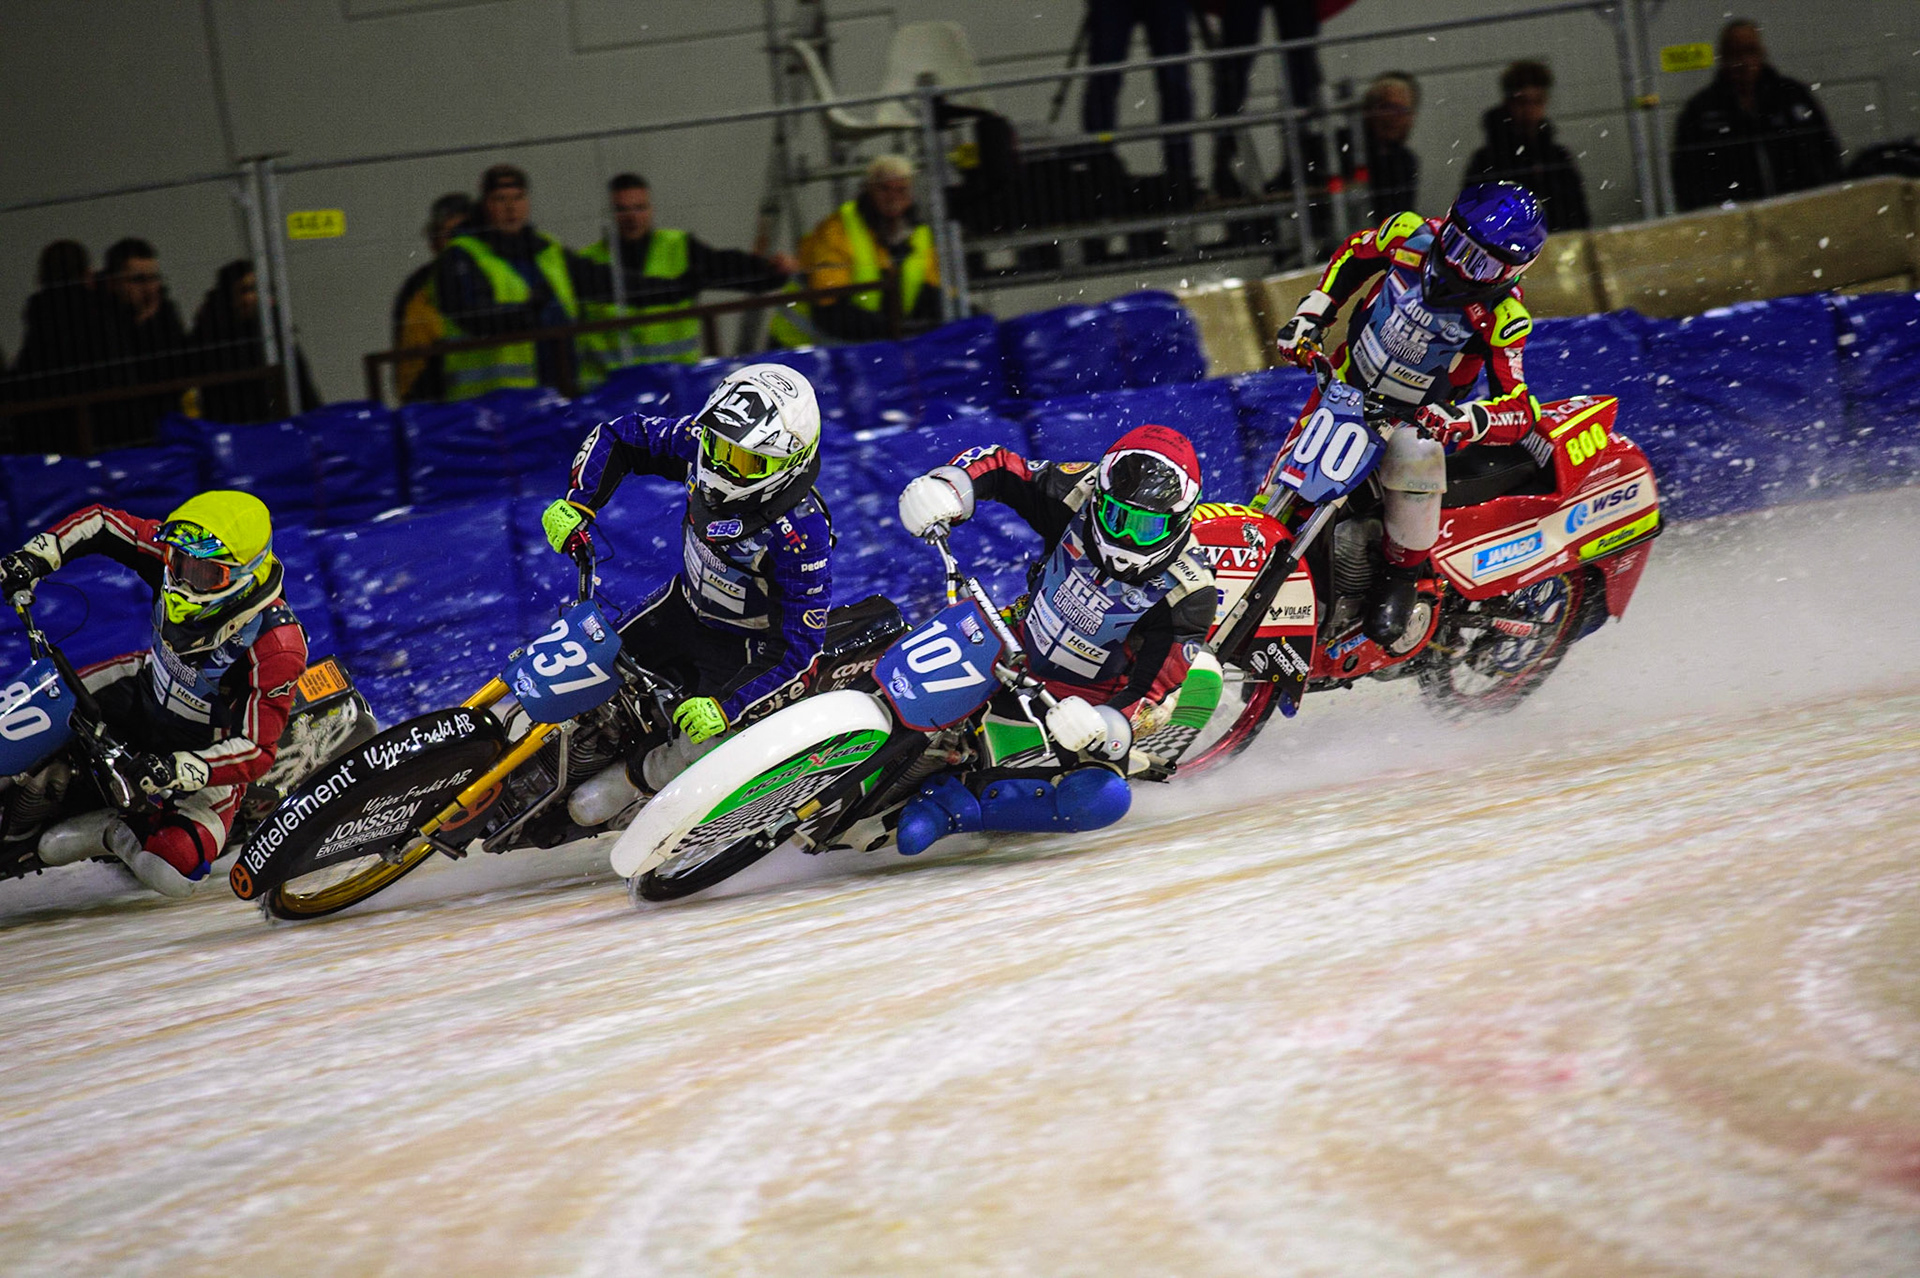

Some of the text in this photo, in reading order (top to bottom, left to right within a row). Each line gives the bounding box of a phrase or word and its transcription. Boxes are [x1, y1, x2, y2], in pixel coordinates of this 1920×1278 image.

[1405, 299, 1434, 327] 800
[1393, 366, 1429, 386] Hertz
[1565, 422, 1608, 466] 800
[1592, 482, 1641, 514] WSG
[709, 573, 742, 595] Hertz
[1062, 567, 1115, 619] ICE
[1053, 589, 1100, 637] GLADIATORS
[1284, 605, 1312, 616] VOLARE
[527, 619, 611, 695] 237
[901, 620, 986, 693] 107
[1067, 635, 1103, 659] Hertz
[177, 687, 207, 710] Hertz
[454, 713, 476, 734] AB
[444, 768, 474, 789] AB
[741, 765, 803, 799] MOTO
[325, 801, 422, 844] JONSSON
[316, 821, 409, 858] ENTREPRENAD AB
